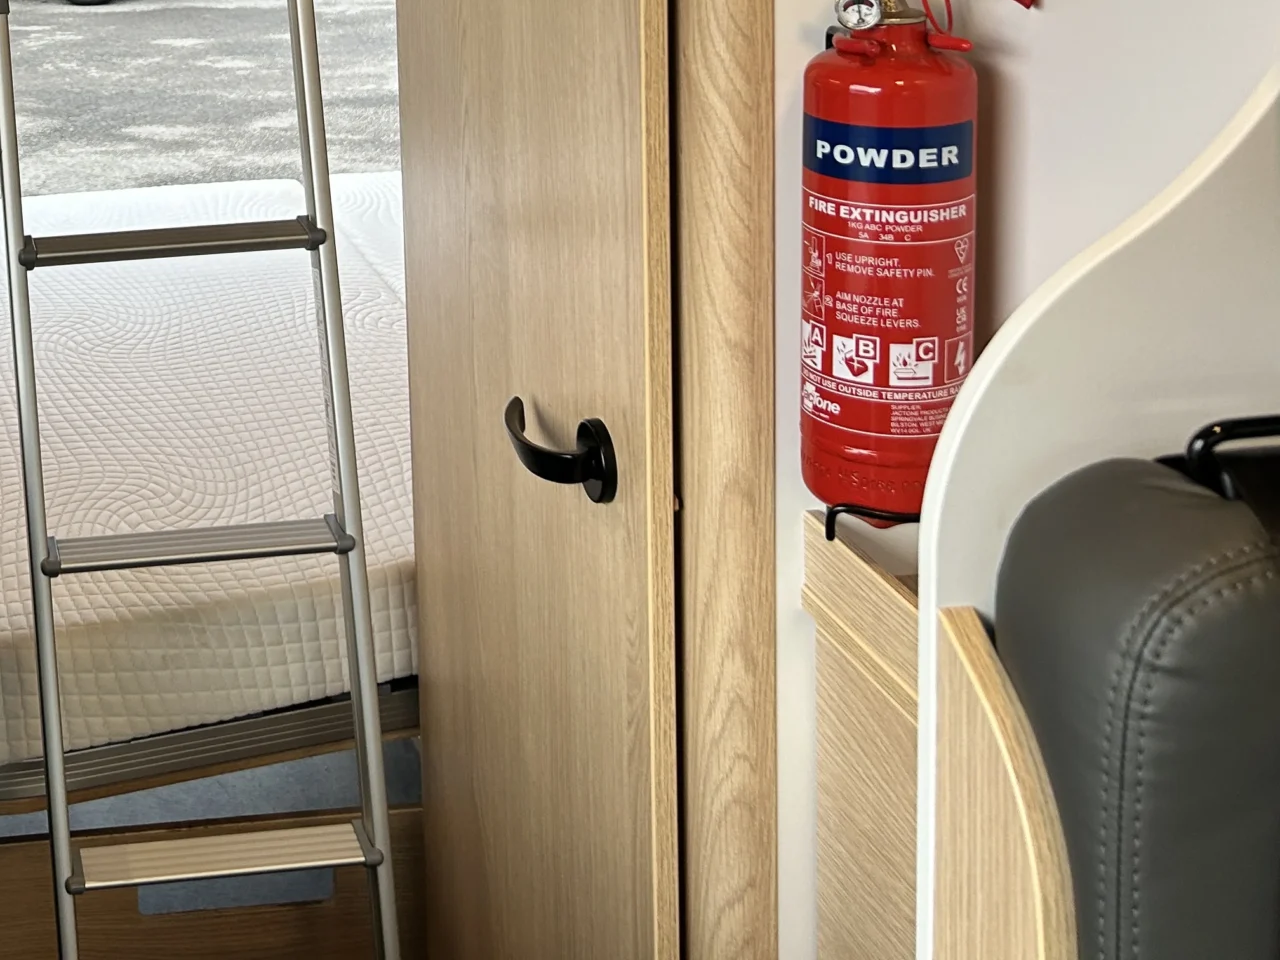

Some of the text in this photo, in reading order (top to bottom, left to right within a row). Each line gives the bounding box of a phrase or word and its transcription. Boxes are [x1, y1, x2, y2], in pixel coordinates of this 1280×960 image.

[815, 139, 960, 169] POWDER
[808, 195, 967, 224] FIRE EXTINGUISHER
[864, 223, 882, 231] ABC
[885, 224, 923, 233] POWDER
[904, 234, 912, 242] C
[835, 251, 853, 263] USE
[835, 261, 874, 276] REMOVE
[876, 267, 915, 278] SAFETY
[835, 290, 851, 301] AIM
[852, 293, 890, 307] NOZZLE
[891, 297, 904, 308] AT
[835, 300, 859, 314] BASE
[860, 305, 873, 315] OF
[835, 310, 878, 327] SQUEEZE
[811, 327, 823, 345] A
[858, 340, 875, 357] B
[918, 342, 934, 359] C
[822, 378, 837, 390] USE
[838, 384, 879, 399] OUTSIDE
[881, 388, 949, 401] TEMPERATURE
